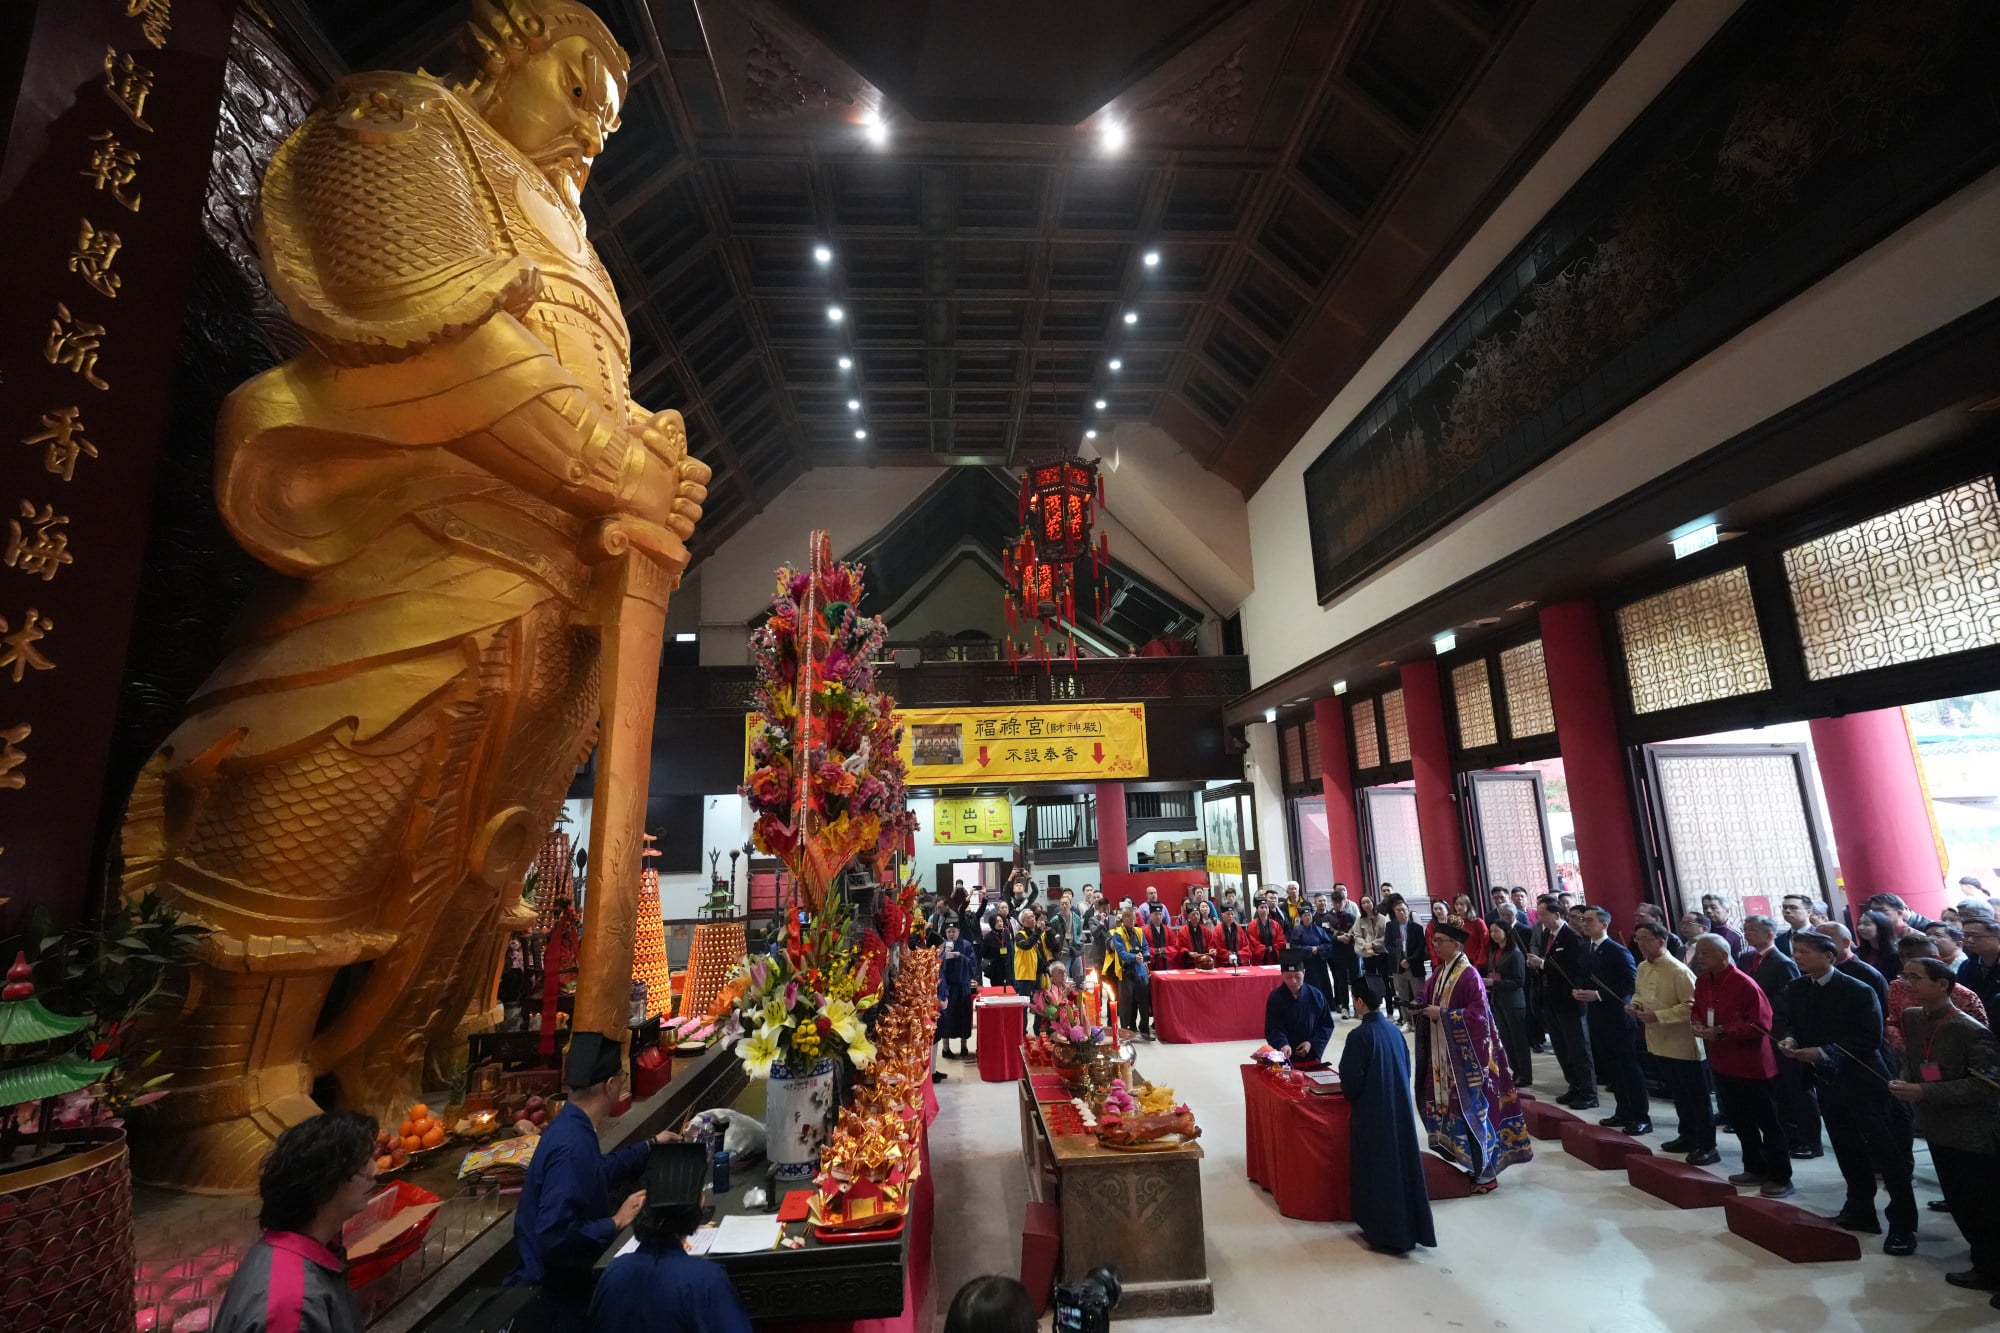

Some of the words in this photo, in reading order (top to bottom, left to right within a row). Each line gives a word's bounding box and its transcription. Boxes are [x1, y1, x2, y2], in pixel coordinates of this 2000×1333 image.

[1005, 746, 1078, 763] 不設奉香
[963, 807, 977, 834] 出口
